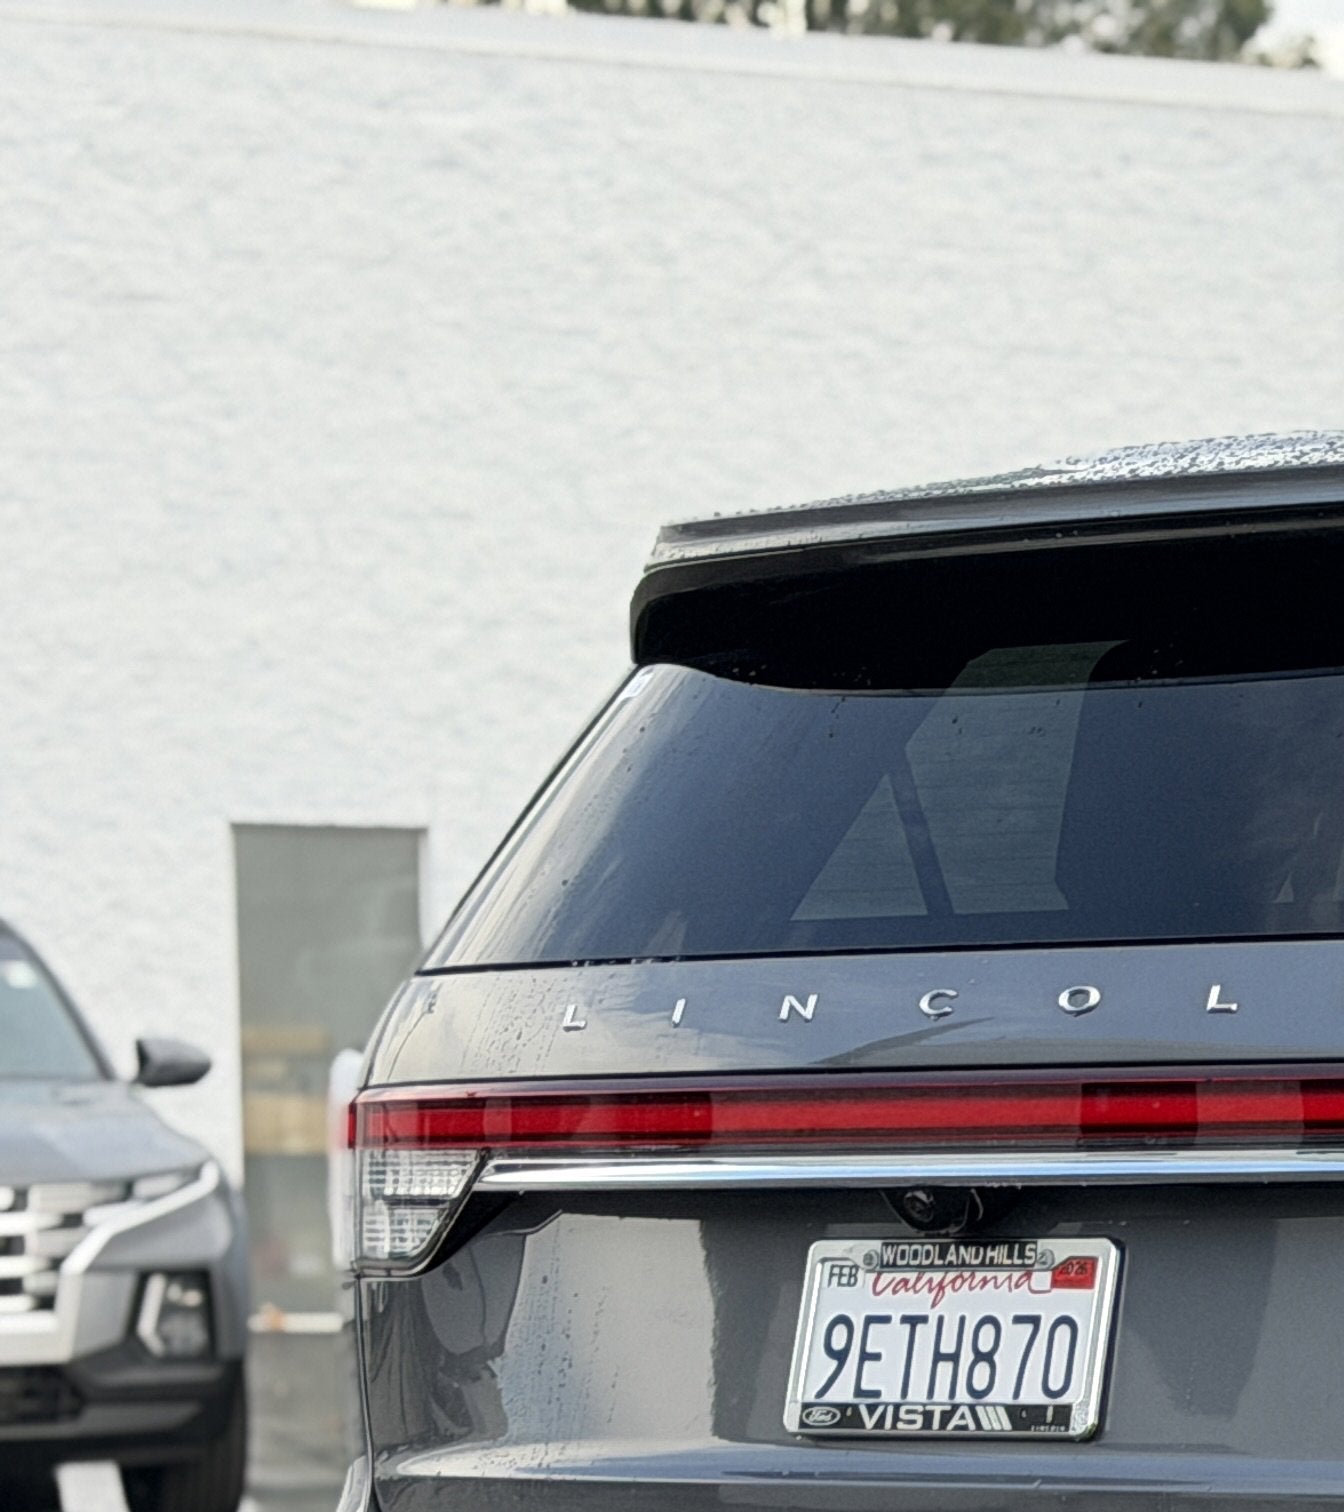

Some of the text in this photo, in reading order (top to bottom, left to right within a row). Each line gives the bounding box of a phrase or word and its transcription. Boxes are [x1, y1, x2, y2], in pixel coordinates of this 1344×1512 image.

[881, 1242, 1036, 1266] WOODLAND HILLS
[828, 1263, 859, 1288] FEB
[814, 1313, 1079, 1401] 9ETH870
[858, 1404, 976, 1431] VISTA
